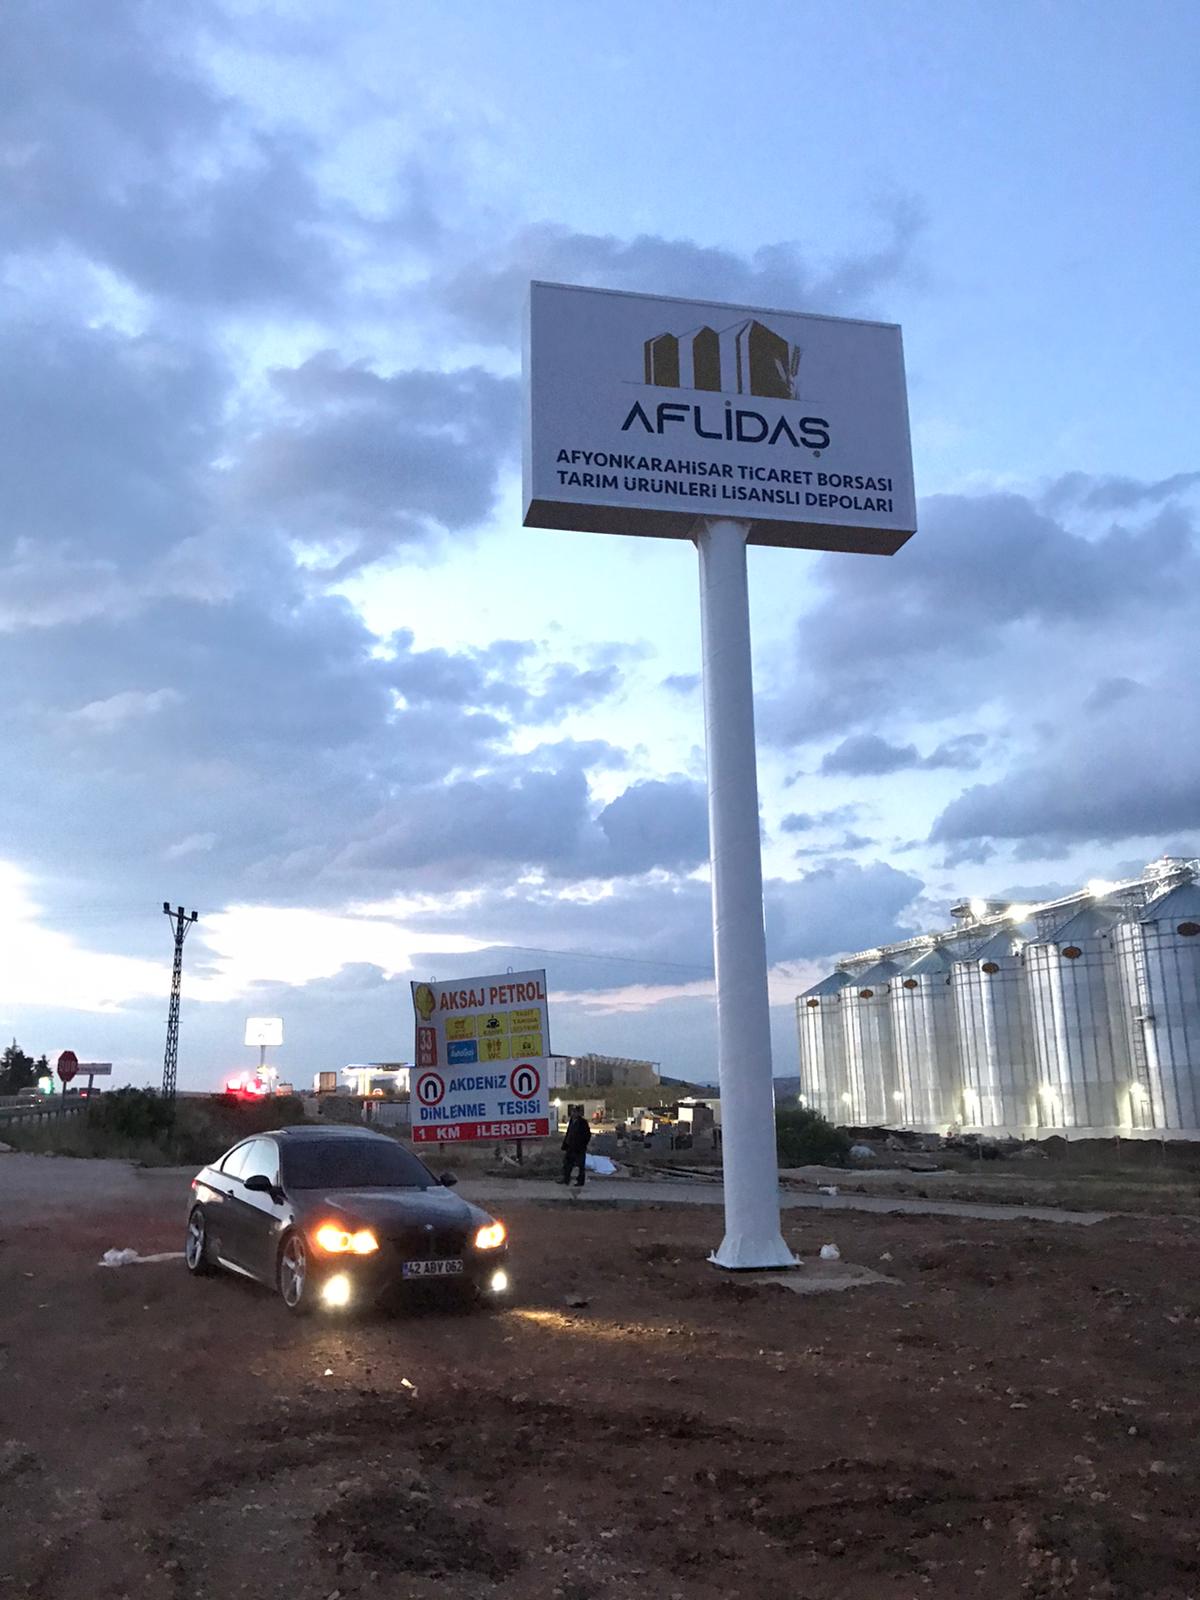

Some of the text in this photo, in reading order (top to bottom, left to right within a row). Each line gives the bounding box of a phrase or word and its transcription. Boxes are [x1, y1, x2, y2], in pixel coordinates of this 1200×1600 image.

[621, 400, 831, 458] AFLİDAŞ
[556, 448, 893, 492] AFYONKARAHİSAR TİCARET BORSASI
[557, 470, 893, 513] TARIM ÜRÜNLERİ LİSANSLI DEPOLARI
[440, 981, 545, 1011] AKSAJ PETROL
[449, 1075, 507, 1093] AKDENİZ
[420, 1099, 541, 1121] DİNLENME TESİSİ
[418, 1122, 537, 1139] 1 KM İLERİDE
